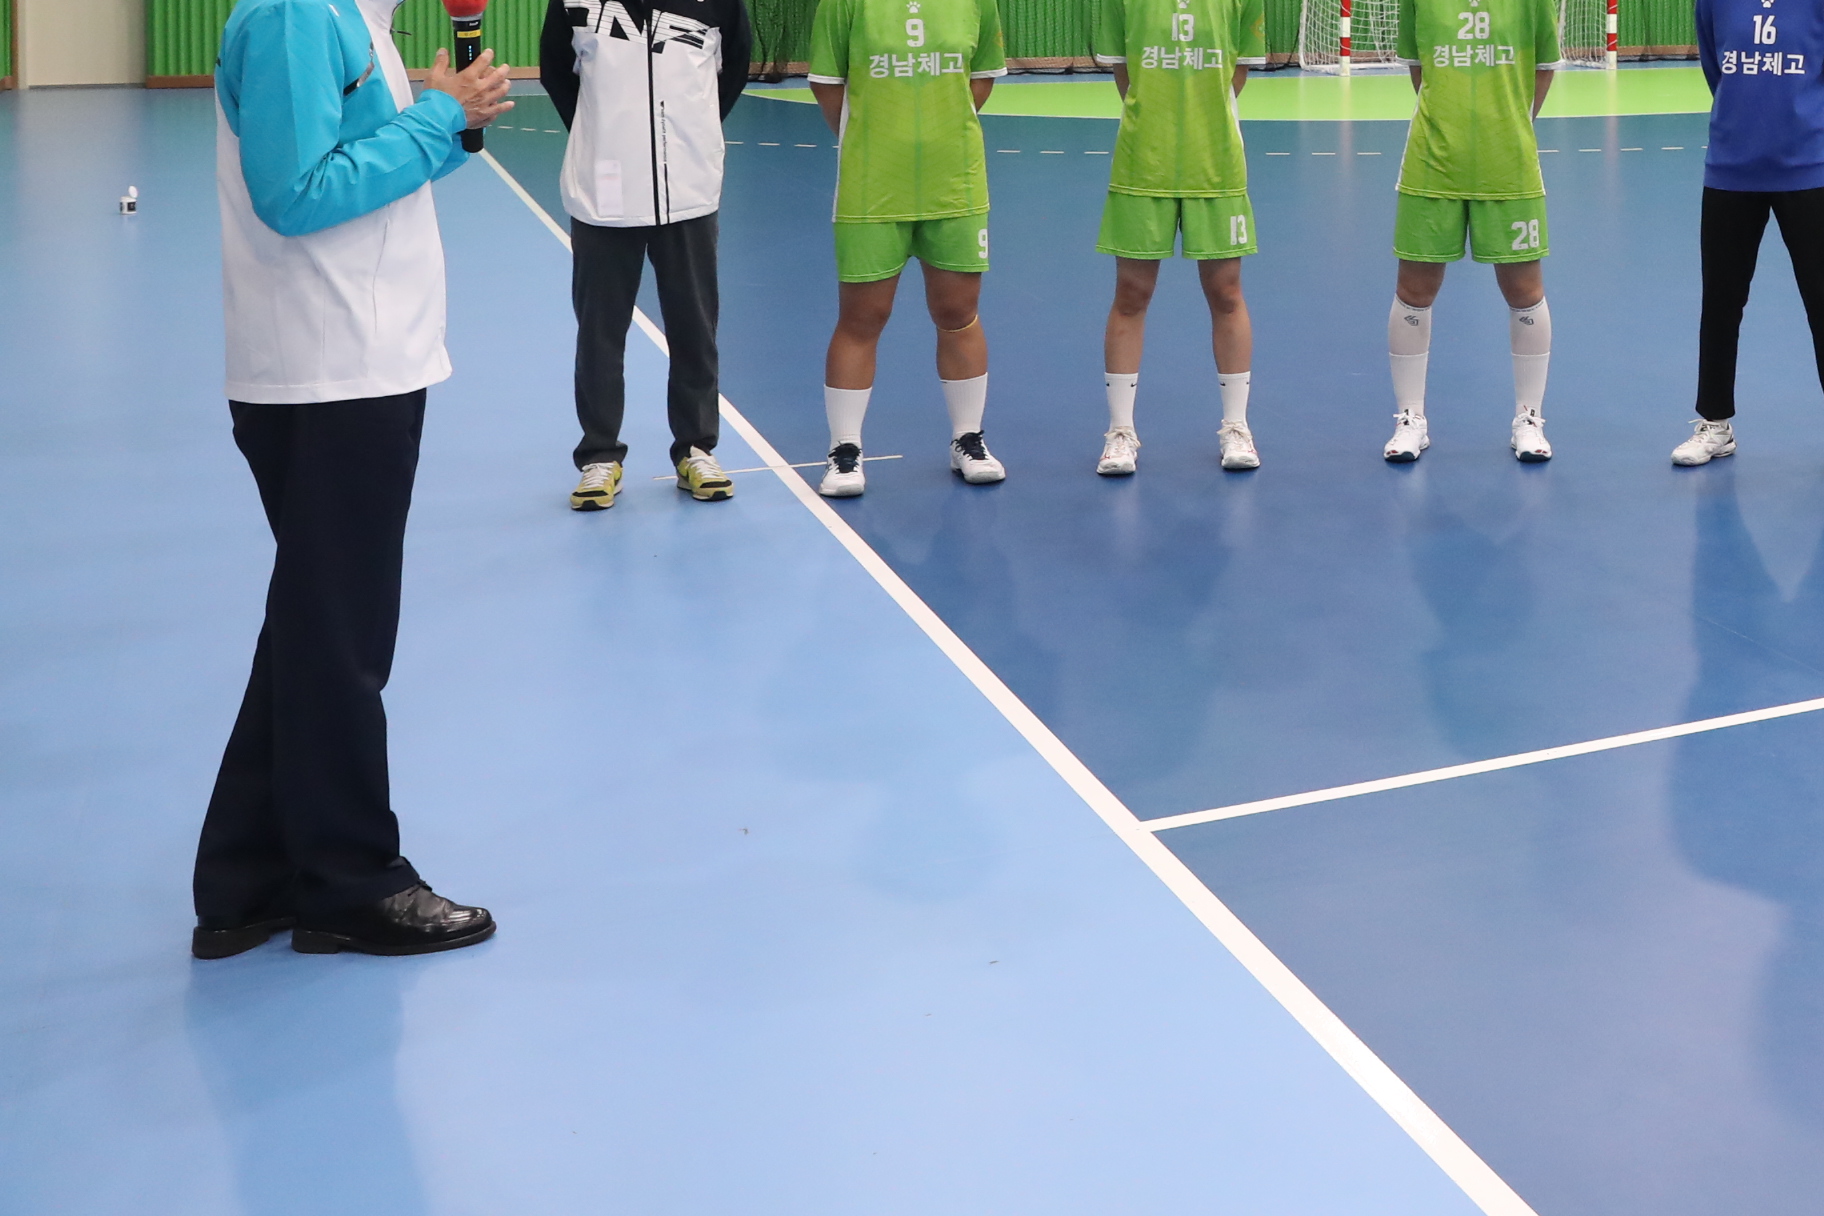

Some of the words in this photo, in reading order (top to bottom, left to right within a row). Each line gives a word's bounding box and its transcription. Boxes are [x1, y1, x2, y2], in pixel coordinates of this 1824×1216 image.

[905, 18, 926, 48] 9
[1171, 12, 1195, 42] 13
[1457, 11, 1490, 40] 28
[1753, 14, 1777, 45] 16
[869, 51, 965, 79] 경남체고
[1141, 45, 1224, 71] 경남체고
[1433, 44, 1516, 68] 경남체고
[1721, 50, 1806, 76] 경남체고
[978, 228, 989, 259] 9
[1229, 214, 1248, 246] 13
[1511, 218, 1540, 251] 28
